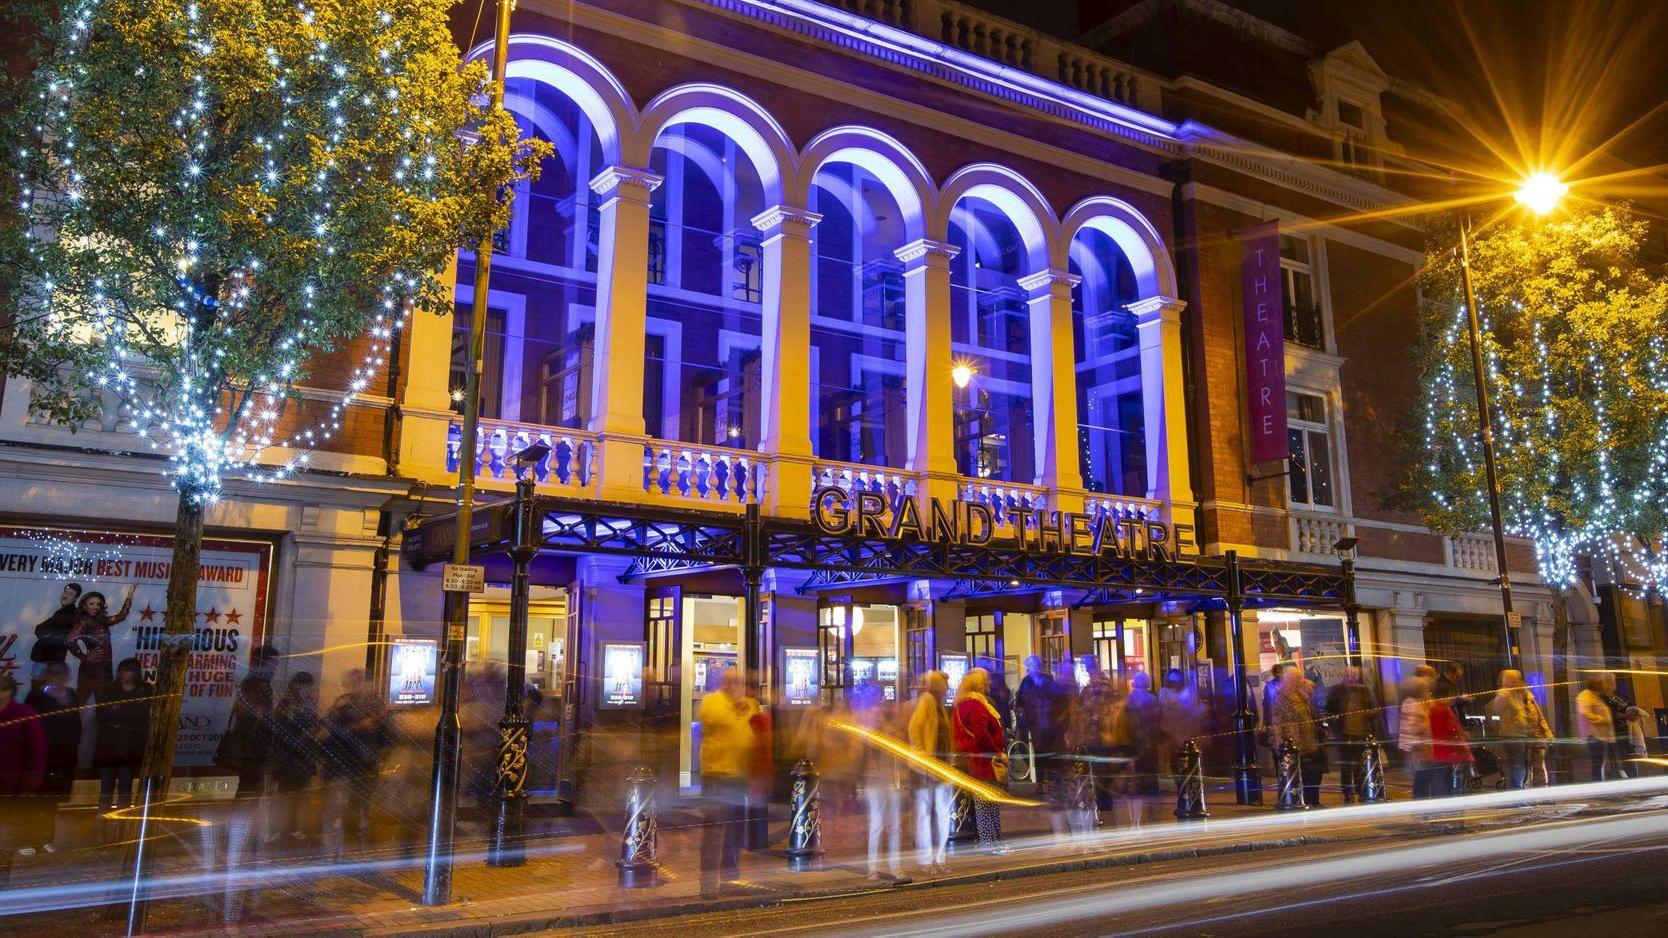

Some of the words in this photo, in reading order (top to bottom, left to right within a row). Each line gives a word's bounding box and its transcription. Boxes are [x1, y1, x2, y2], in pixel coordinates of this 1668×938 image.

[1254, 248, 1273, 435] THEATRE
[808, 484, 995, 546] GRAND
[1007, 507, 1198, 564] THEATRE
[41, 556, 93, 576] MAJOR
[96, 559, 132, 577] BEST
[134, 561, 171, 580] MUSI
[199, 565, 243, 583] AWARD
[189, 671, 234, 682] HUGE
[190, 684, 205, 697] OF
